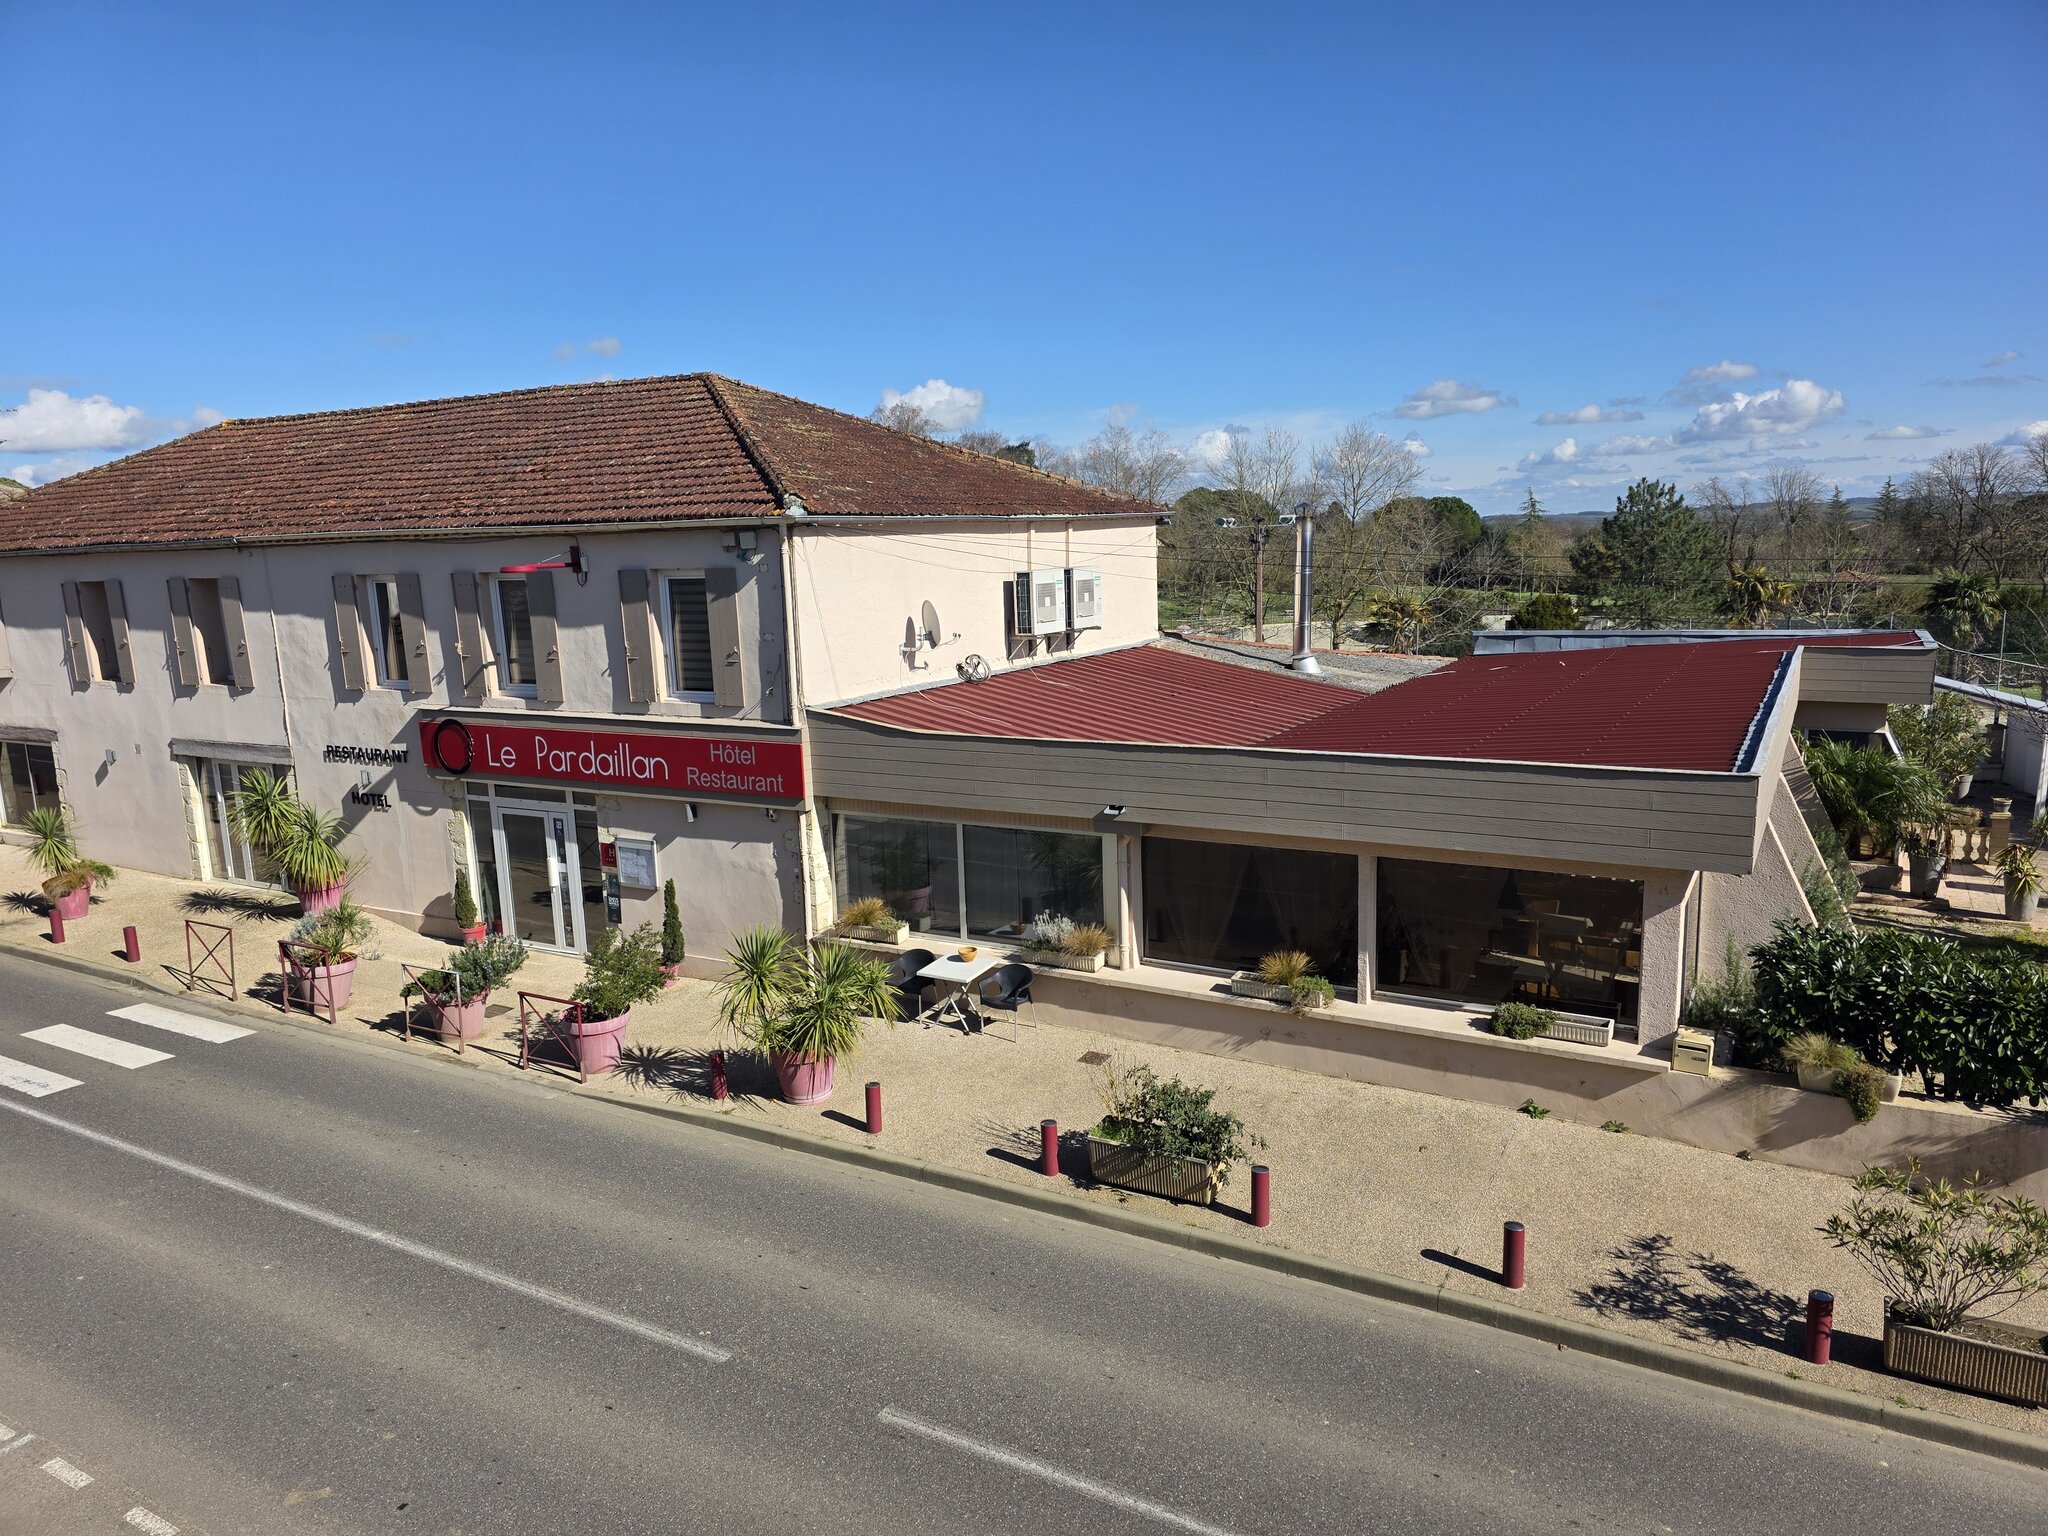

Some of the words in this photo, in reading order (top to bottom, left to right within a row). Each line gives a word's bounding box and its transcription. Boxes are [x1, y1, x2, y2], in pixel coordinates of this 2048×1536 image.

[326, 744, 409, 764] RESTAURANT
[485, 733, 517, 769] Le
[534, 735, 670, 781] Pardaillan
[709, 743, 756, 766] Hôtel
[686, 766, 785, 793] Restaurant
[351, 791, 392, 808] HOTEL
[608, 847, 616, 858] H
